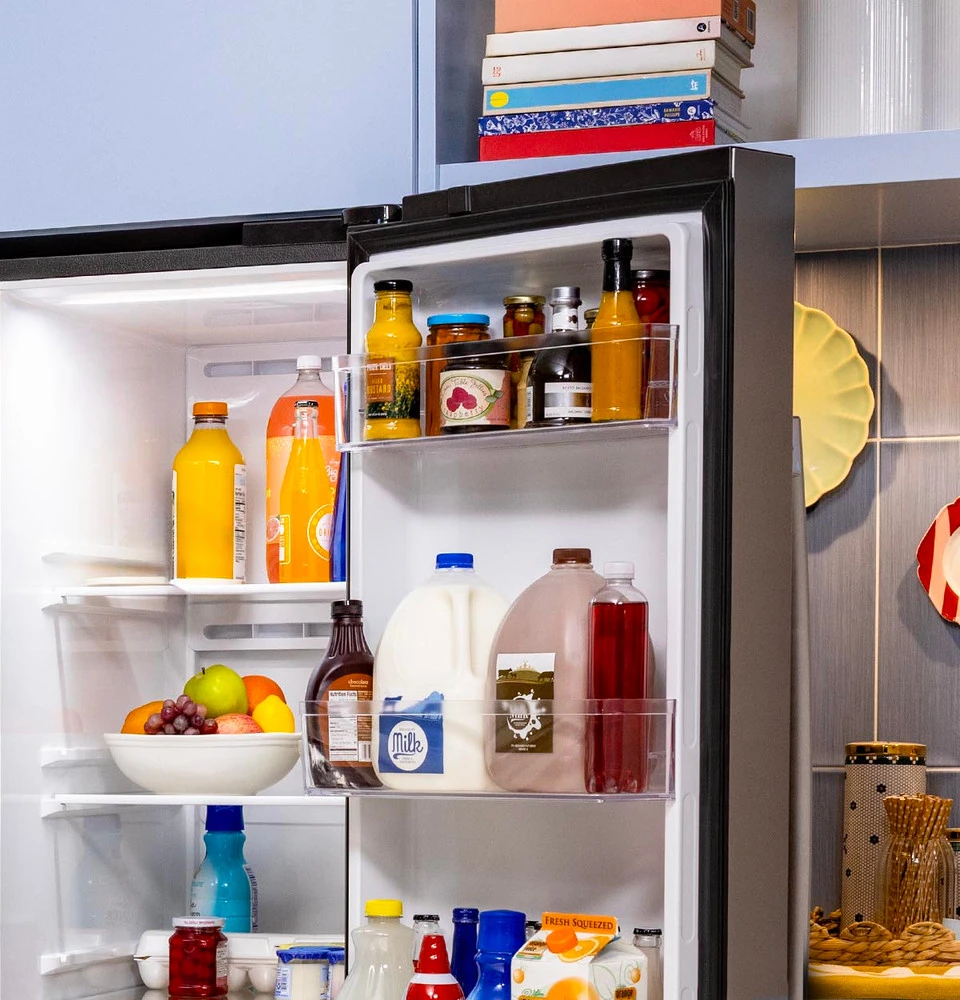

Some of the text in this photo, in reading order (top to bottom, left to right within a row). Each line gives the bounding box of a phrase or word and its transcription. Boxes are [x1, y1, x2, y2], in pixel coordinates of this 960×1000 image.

[392, 731, 424, 753] Milk
[545, 916, 614, 930] FRESH SQUEEZED
